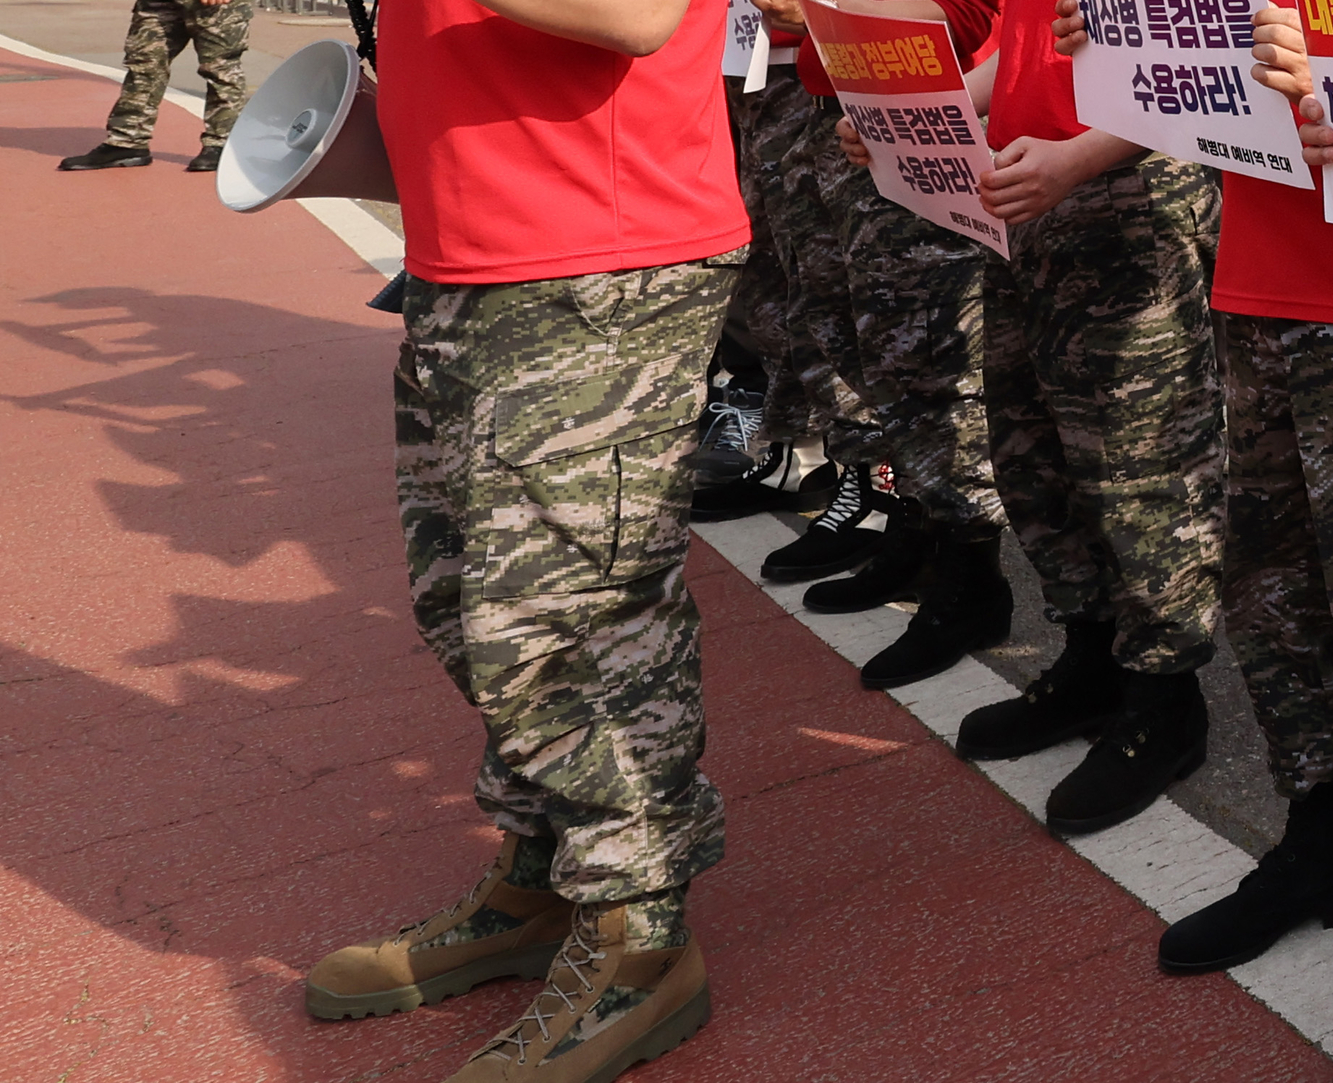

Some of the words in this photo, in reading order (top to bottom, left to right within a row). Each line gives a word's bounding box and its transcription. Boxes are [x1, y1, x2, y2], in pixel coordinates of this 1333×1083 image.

[861, 34, 943, 79] 정부여당
[1131, 63, 1252, 117] 수용하라!
[844, 103, 896, 144] 채상병
[886, 104, 976, 146] 특검법을
[897, 155, 981, 195] 수용하라!
[1197, 137, 1229, 160] 해병대
[1231, 146, 1267, 168] 예비역
[1267, 156, 1293, 174] 연대
